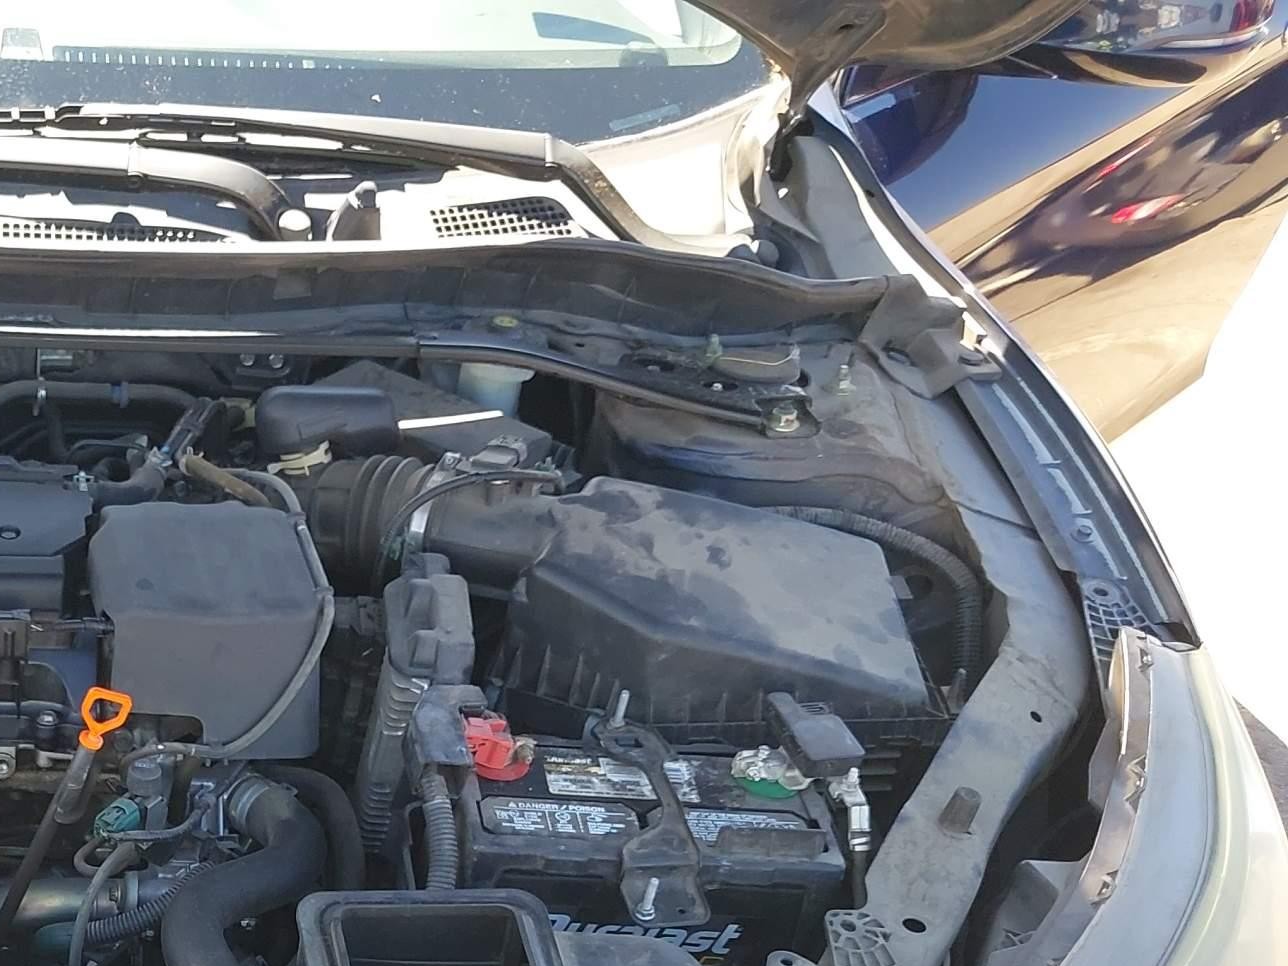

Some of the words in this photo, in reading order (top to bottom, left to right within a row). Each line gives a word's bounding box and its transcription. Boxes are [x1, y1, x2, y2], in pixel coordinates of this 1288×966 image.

[518, 802, 559, 811] DANGER
[569, 804, 606, 813] POISON
[548, 913, 743, 955] Dast
